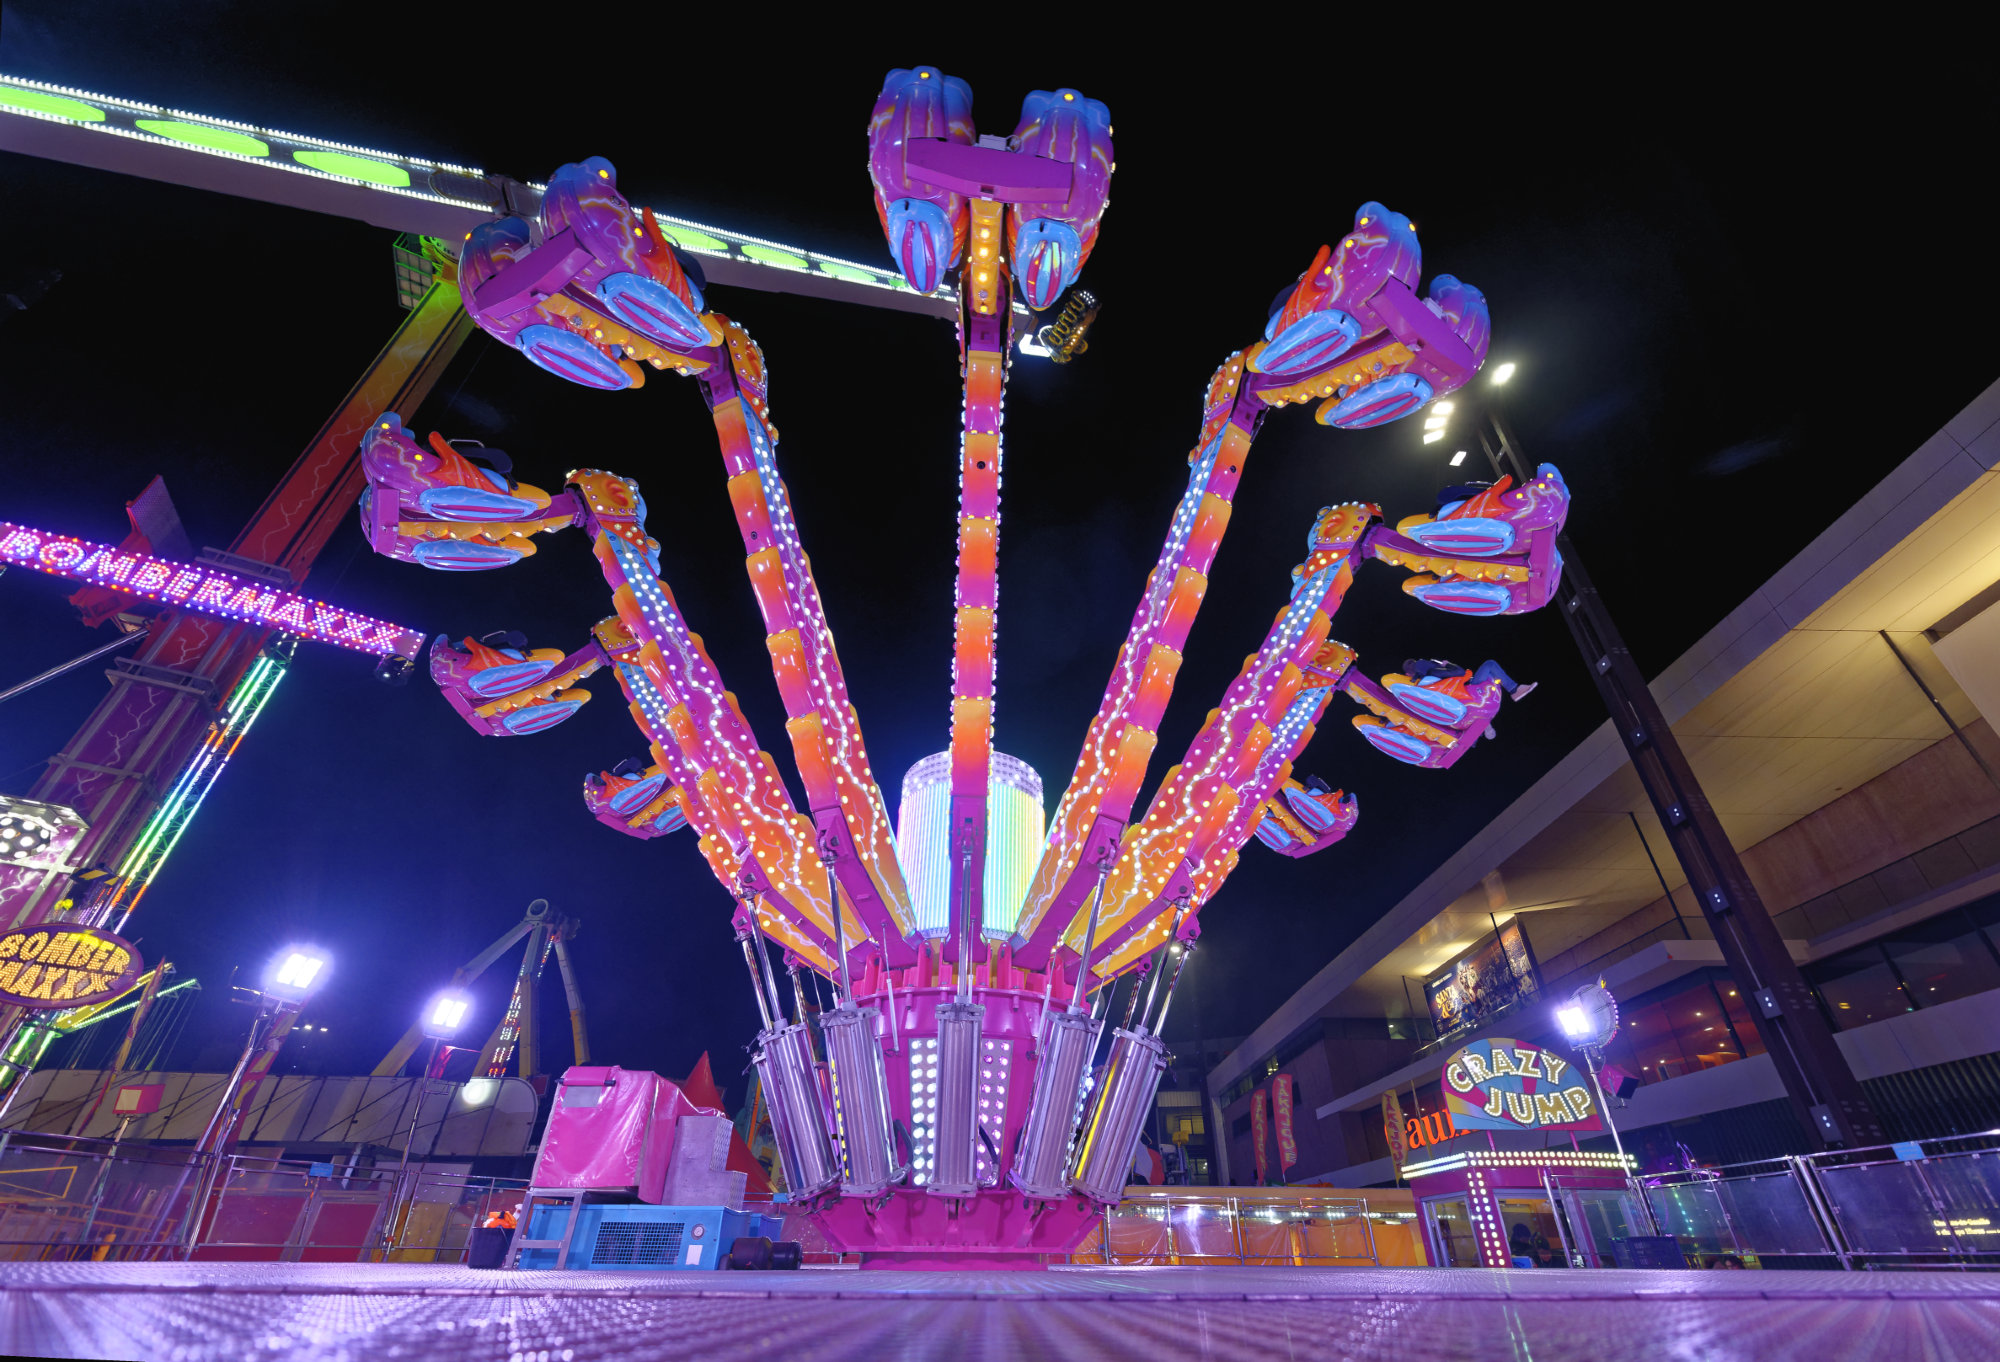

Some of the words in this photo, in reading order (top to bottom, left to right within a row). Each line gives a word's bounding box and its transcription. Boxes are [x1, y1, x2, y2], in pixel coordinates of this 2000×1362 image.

[0, 931, 131, 974] BOMBER
[1446, 1048, 1567, 1093] CRAZY
[1483, 1085, 1592, 1125] JUMP
